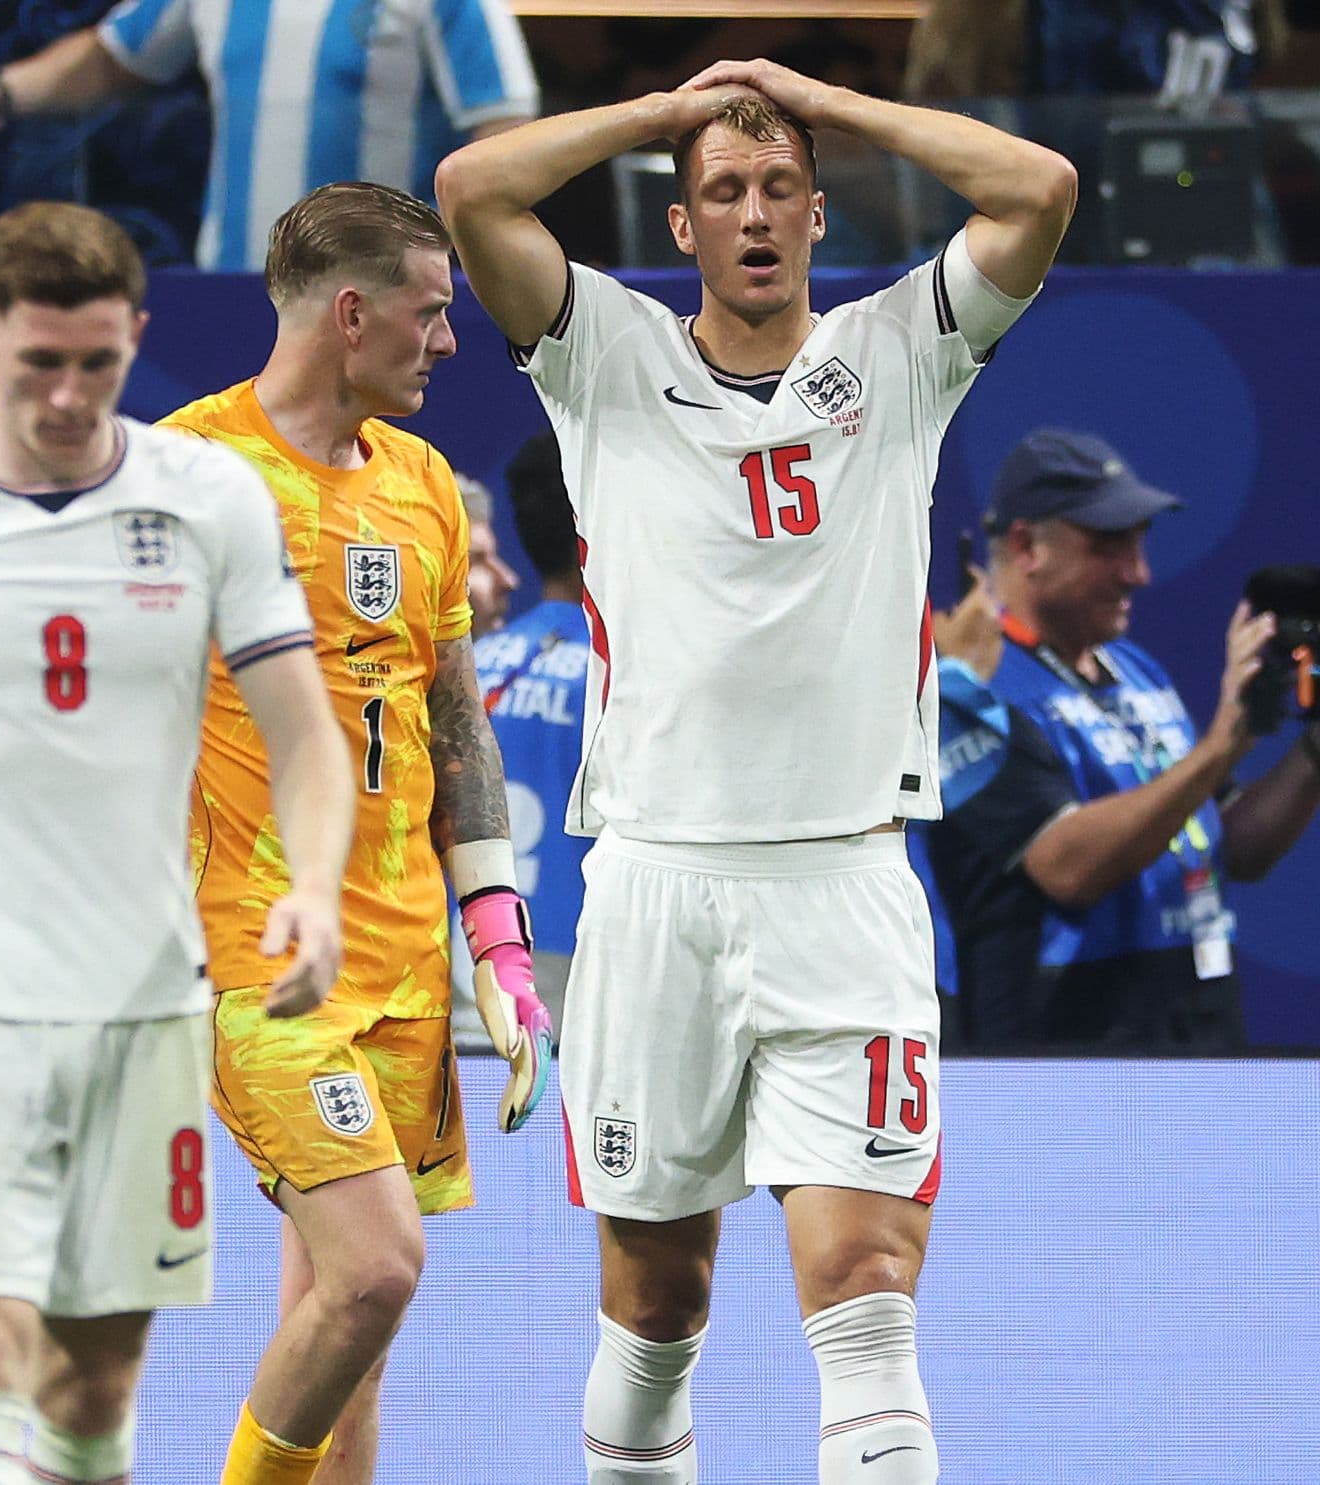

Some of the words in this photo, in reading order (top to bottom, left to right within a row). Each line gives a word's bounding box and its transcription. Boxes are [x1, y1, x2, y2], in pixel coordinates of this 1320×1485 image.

[829, 407, 864, 426] ARGENT
[739, 443, 820, 538] 15
[42, 614, 88, 714] 8
[348, 662, 391, 674] ARGENTINA
[361, 696, 384, 793] 1
[864, 1036, 927, 1134] 15
[169, 1128, 205, 1230] 8
